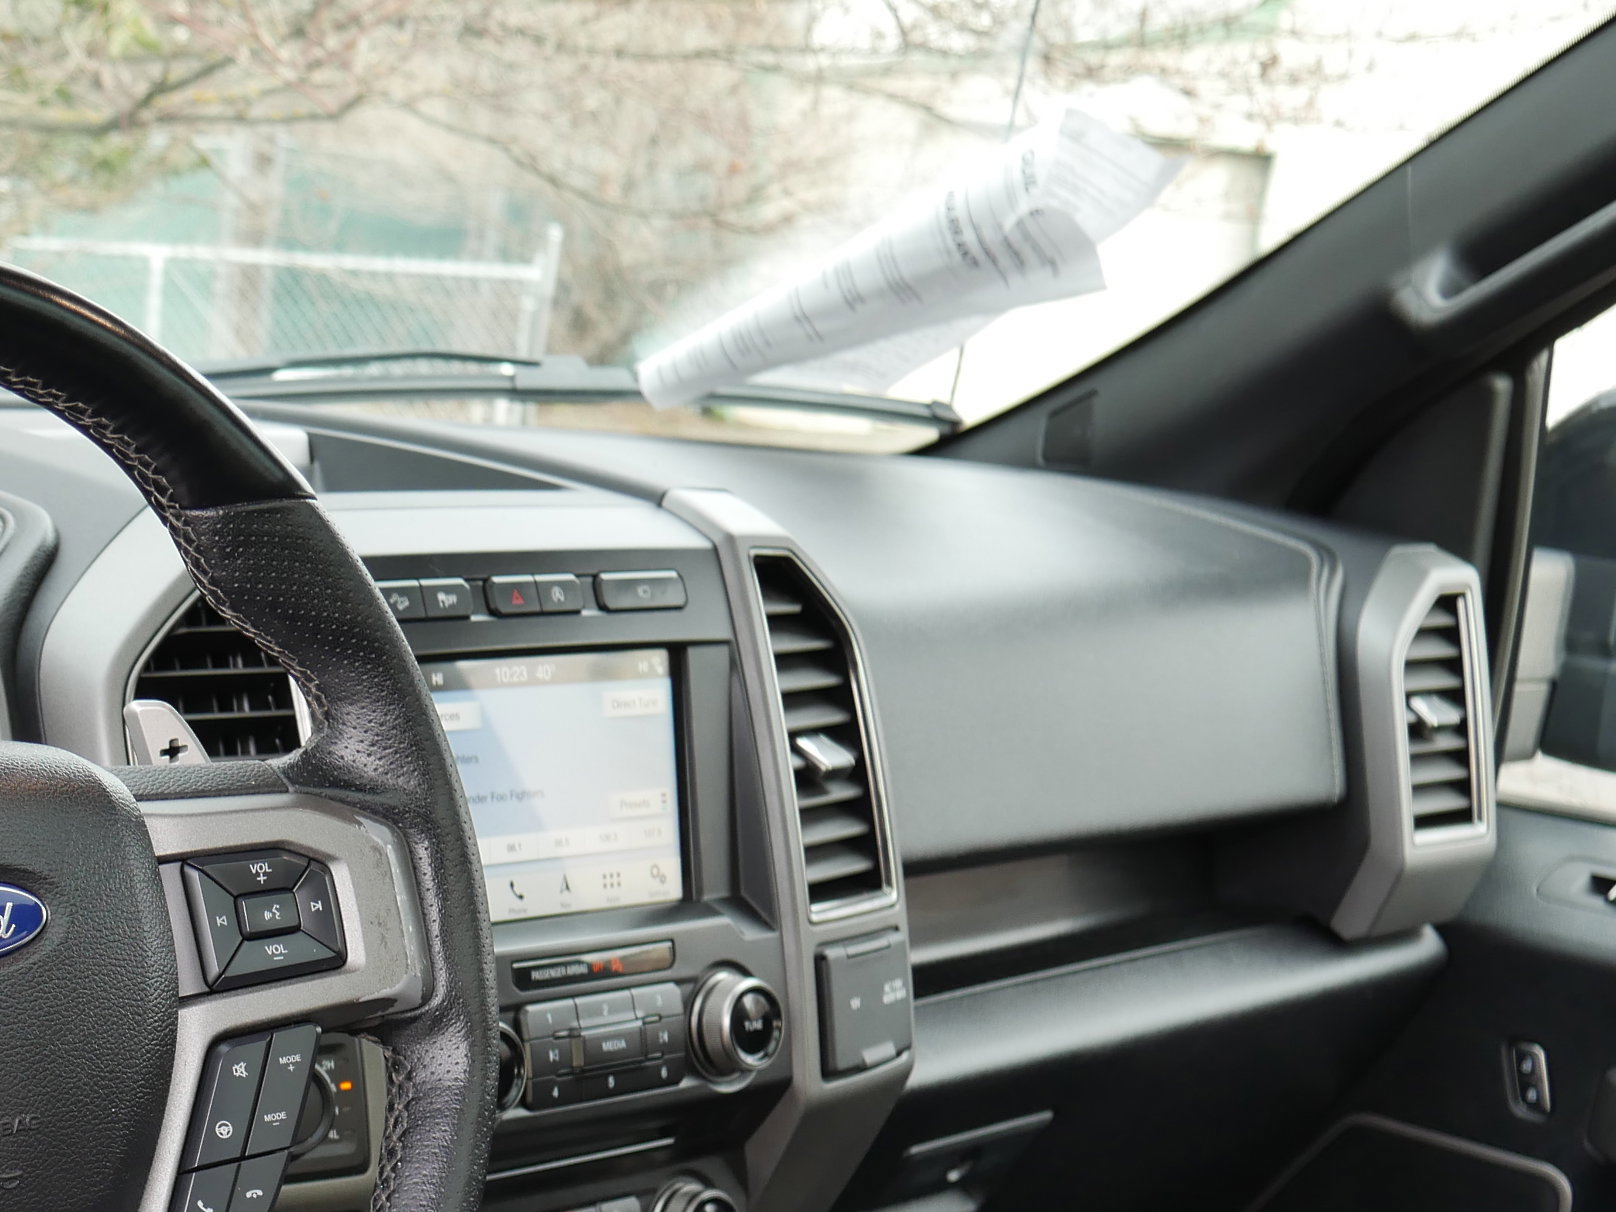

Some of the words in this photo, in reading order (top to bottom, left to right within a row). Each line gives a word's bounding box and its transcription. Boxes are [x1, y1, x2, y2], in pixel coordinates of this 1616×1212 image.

[495, 666, 528, 684] 10:23
[250, 863, 272, 874] VOL
[264, 945, 288, 955] VOL
[602, 1039, 627, 1052] MEDIA
[279, 1054, 301, 1065] MODE
[264, 1111, 287, 1122] MODE
